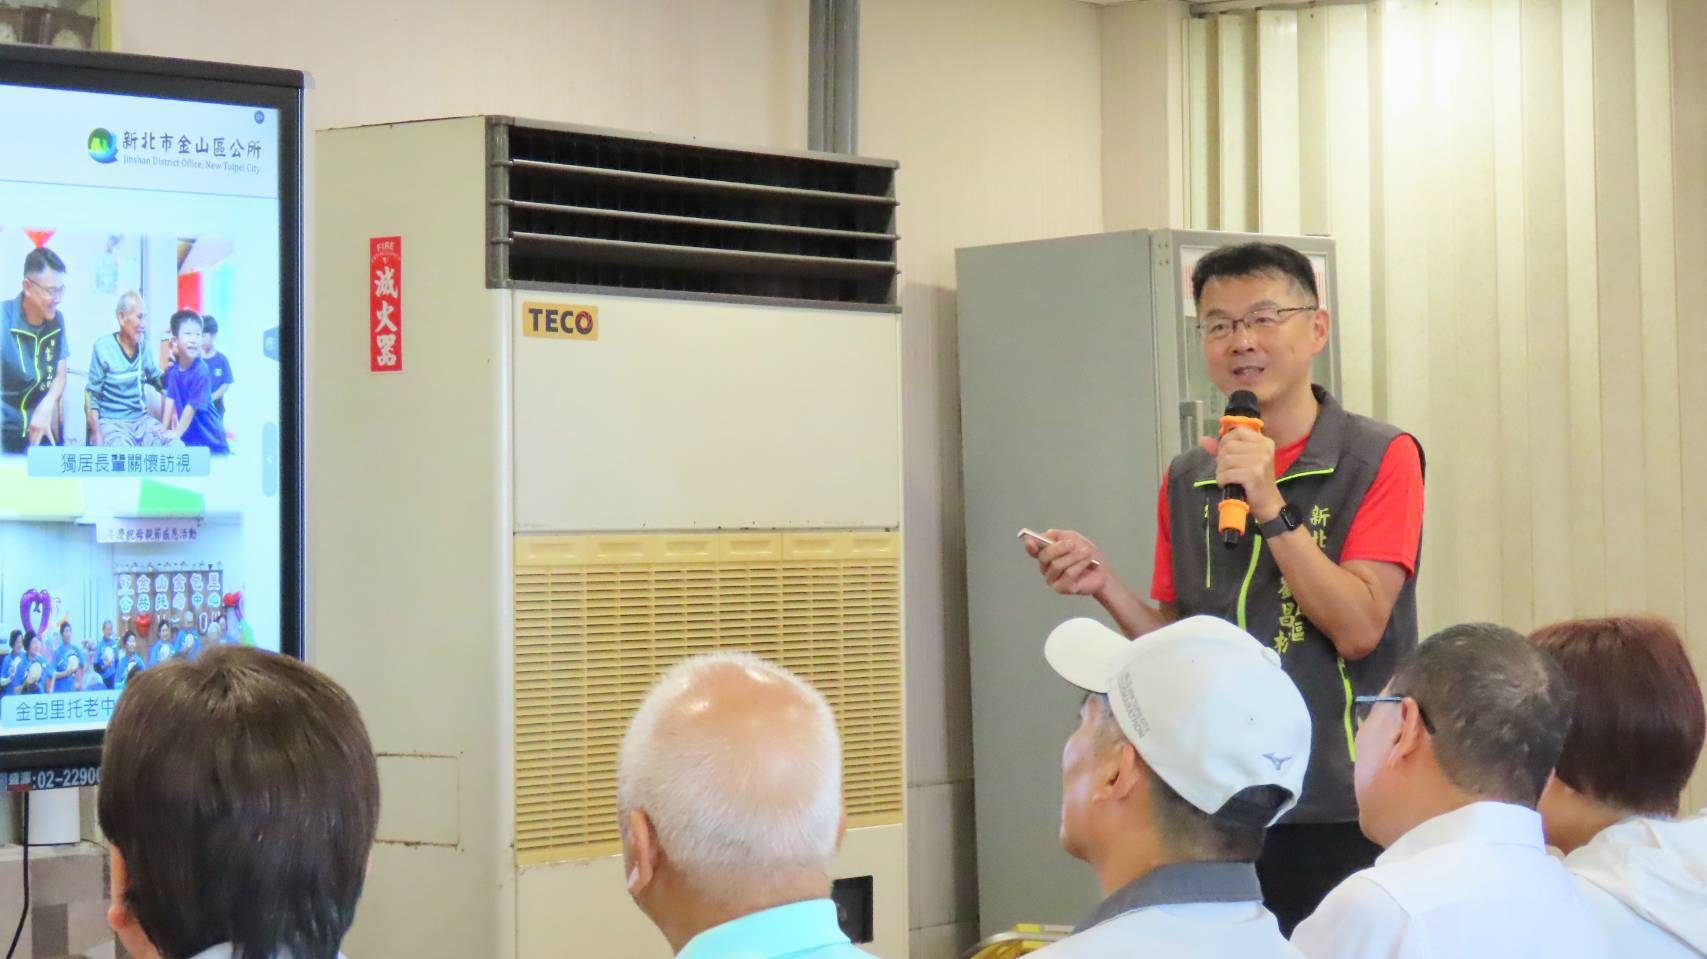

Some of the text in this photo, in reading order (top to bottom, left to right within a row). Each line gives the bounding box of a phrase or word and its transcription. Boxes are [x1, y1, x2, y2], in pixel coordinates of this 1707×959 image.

[122, 130, 262, 159] 新北市金山區公所
[123, 155, 151, 166] Jinshan
[152, 156, 179, 169] District
[205, 160, 222, 170] New
[223, 160, 244, 174] Taipei
[246, 163, 261, 175] City
[376, 241, 395, 252] FIRE
[374, 266, 399, 366] 滅火器
[528, 308, 594, 335] TECO
[61, 453, 191, 473] 獨居長輩關懷訪視
[16, 696, 115, 722] 金包里托老中
